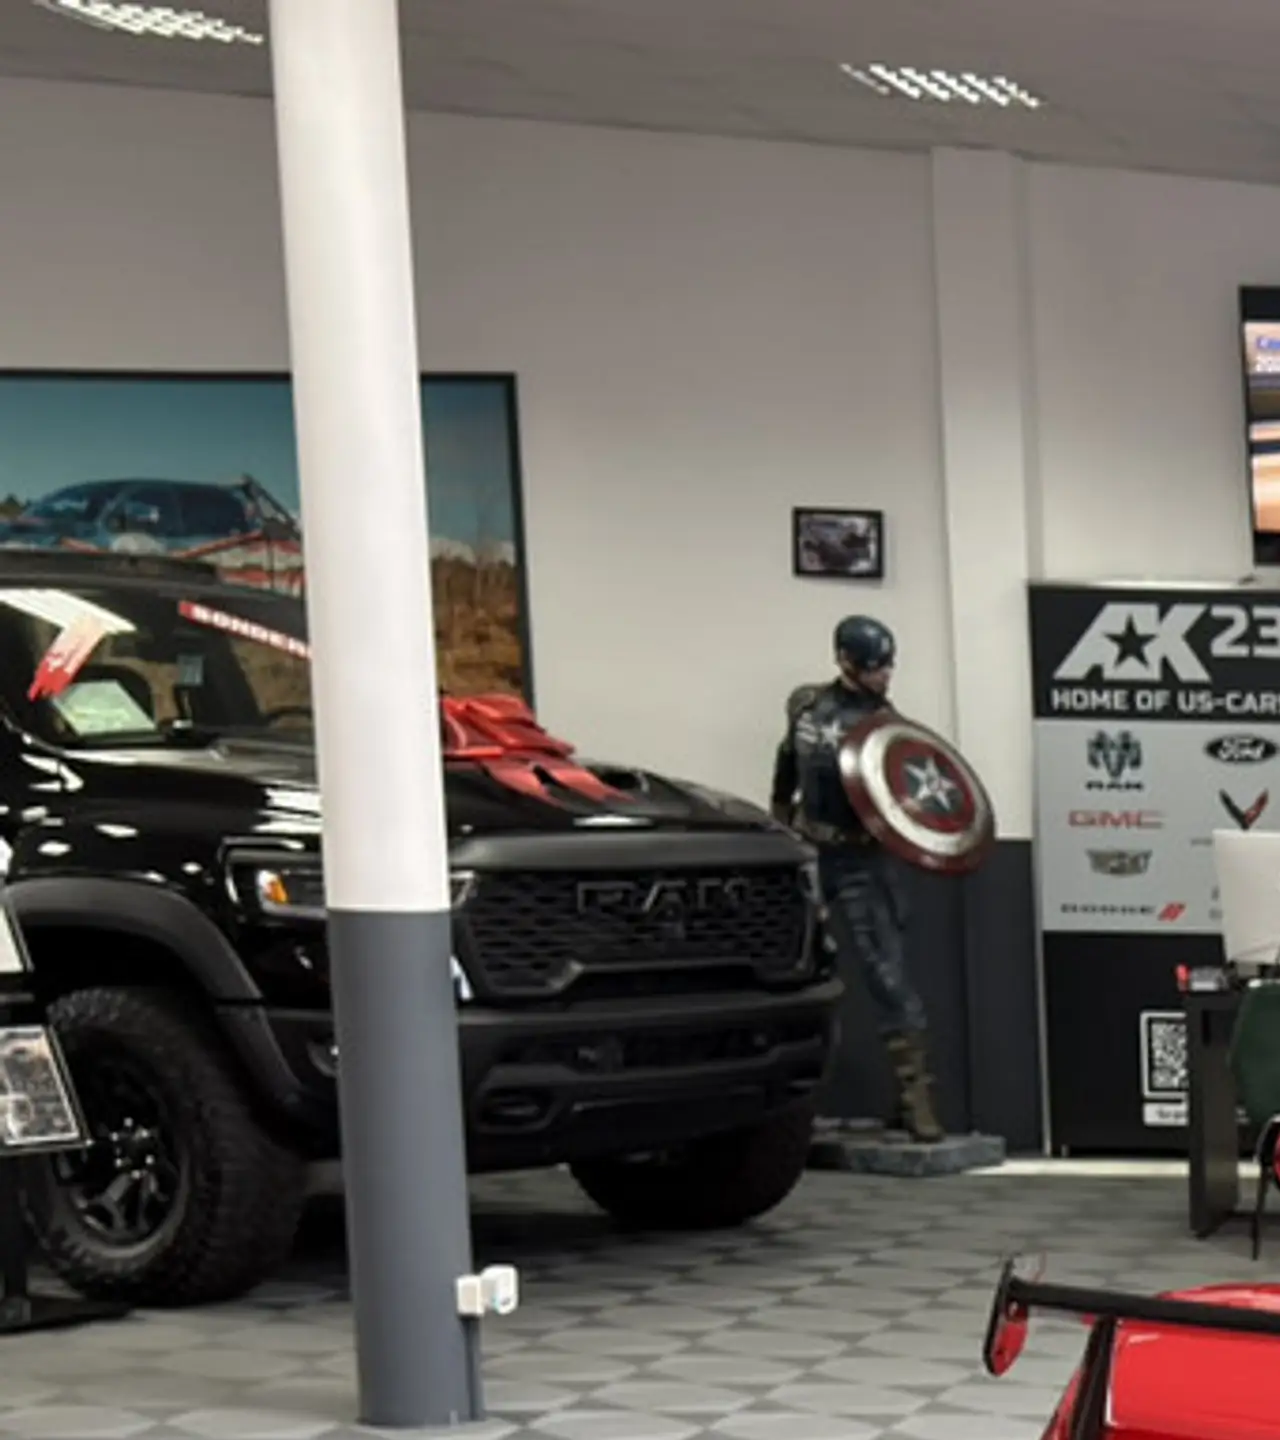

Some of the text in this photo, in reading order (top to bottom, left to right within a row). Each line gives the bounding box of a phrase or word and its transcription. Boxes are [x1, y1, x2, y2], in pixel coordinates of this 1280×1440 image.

[1053, 688, 1130, 711] HOME
[1136, 690, 1171, 712] OF
[1067, 809, 1165, 830] GMC
[577, 877, 752, 917] RAM
